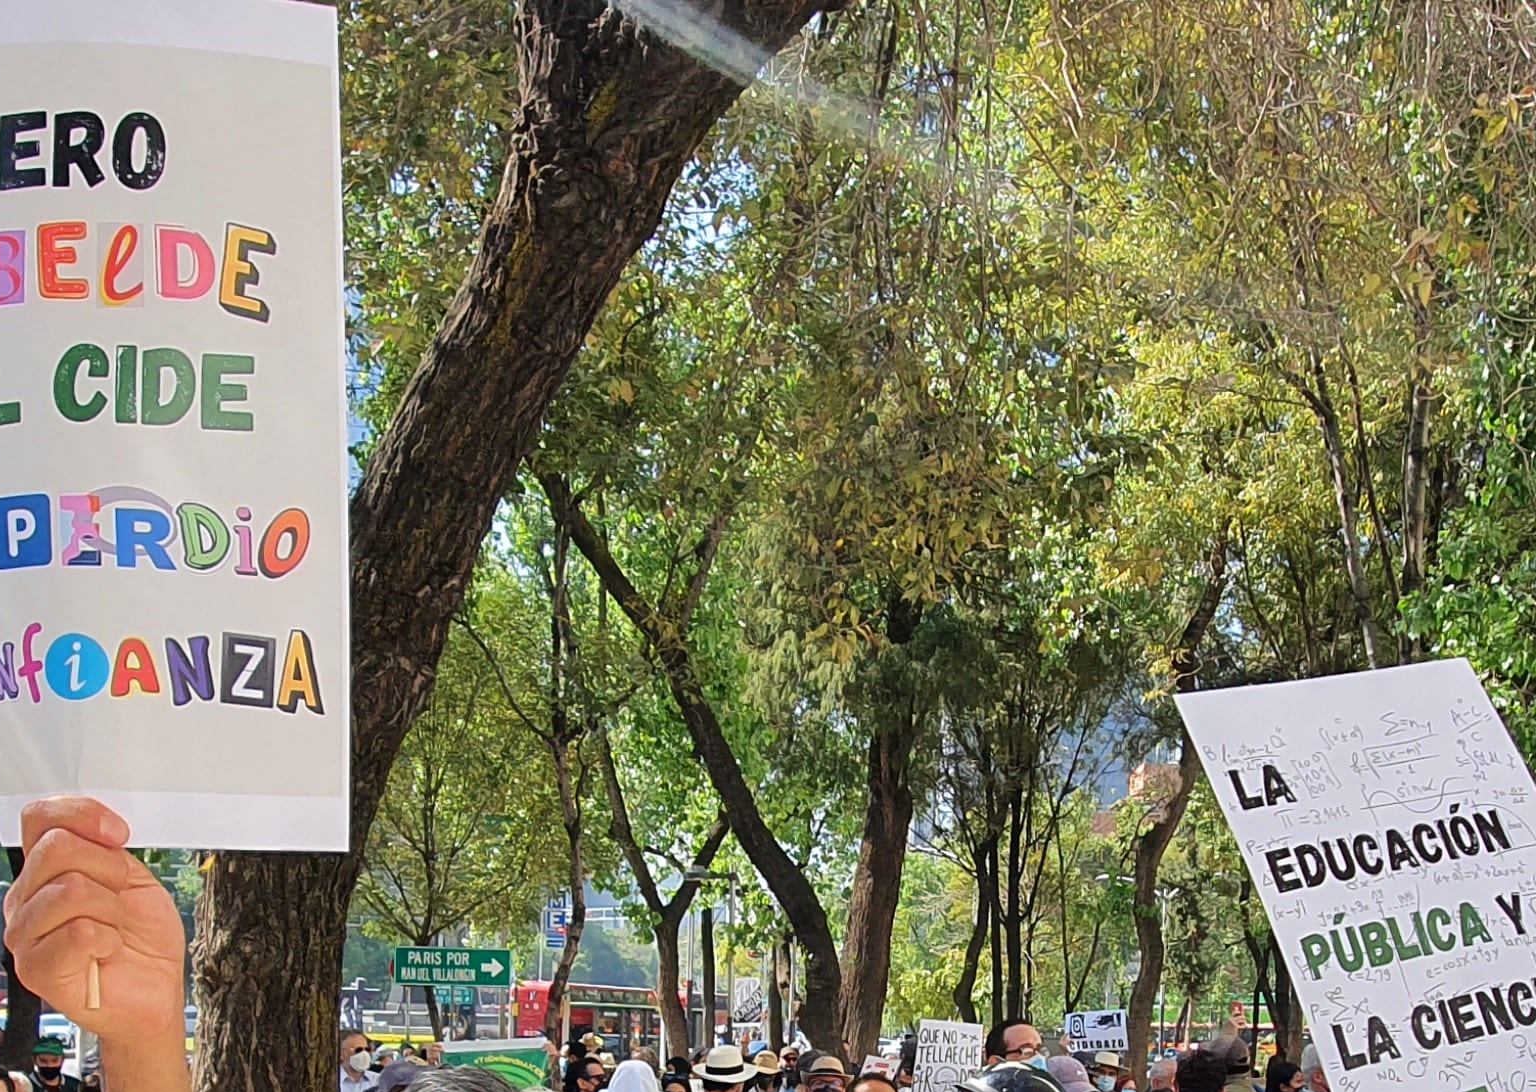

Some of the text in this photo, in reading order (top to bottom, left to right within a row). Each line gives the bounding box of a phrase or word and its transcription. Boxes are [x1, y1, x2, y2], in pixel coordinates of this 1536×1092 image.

[53, 342, 255, 432] CIDE
[1228, 764, 1298, 811] LA
[1264, 802, 1512, 894] EDUCACIÓN
[407, 951, 470, 966] PARIS POR
[1299, 891, 1526, 981] PÚBLICA Y
[918, 1044, 981, 1067] TELLAECHE
[919, 1027, 958, 1044] QUE NO
[1068, 1038, 1125, 1051] CIDEDAZO
[1331, 1014, 1402, 1072] LA
